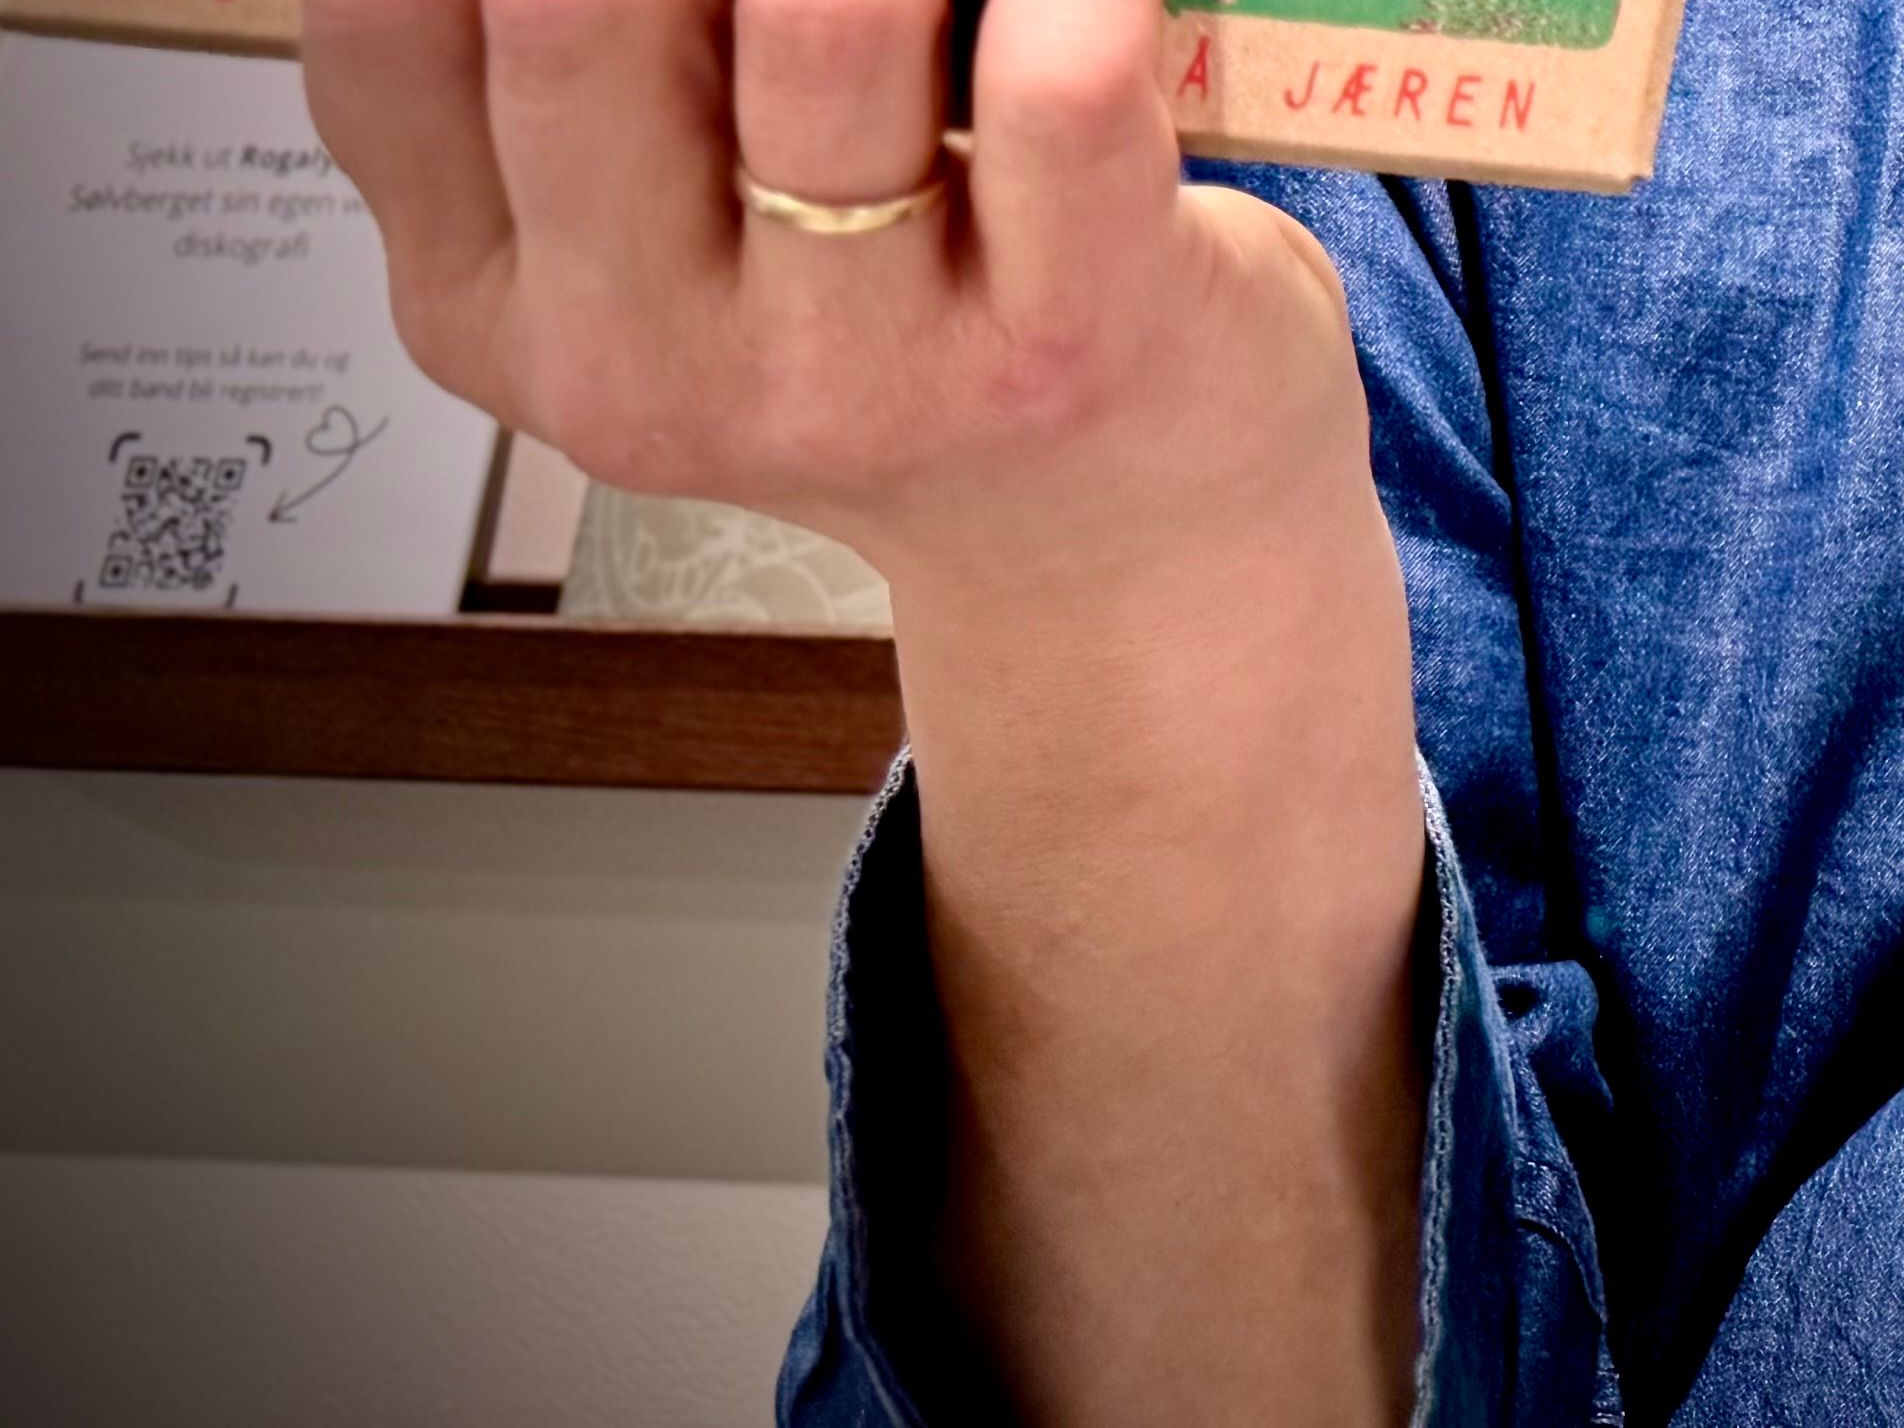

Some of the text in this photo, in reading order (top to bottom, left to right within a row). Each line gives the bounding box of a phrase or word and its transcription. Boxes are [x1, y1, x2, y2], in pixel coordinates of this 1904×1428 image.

[1282, 60, 1538, 133] JÆREN
[127, 141, 194, 176] Sjekk
[239, 144, 333, 176] Rogaly
[222, 186, 260, 212] sin
[268, 193, 336, 221] egen
[172, 231, 311, 266] diskografi
